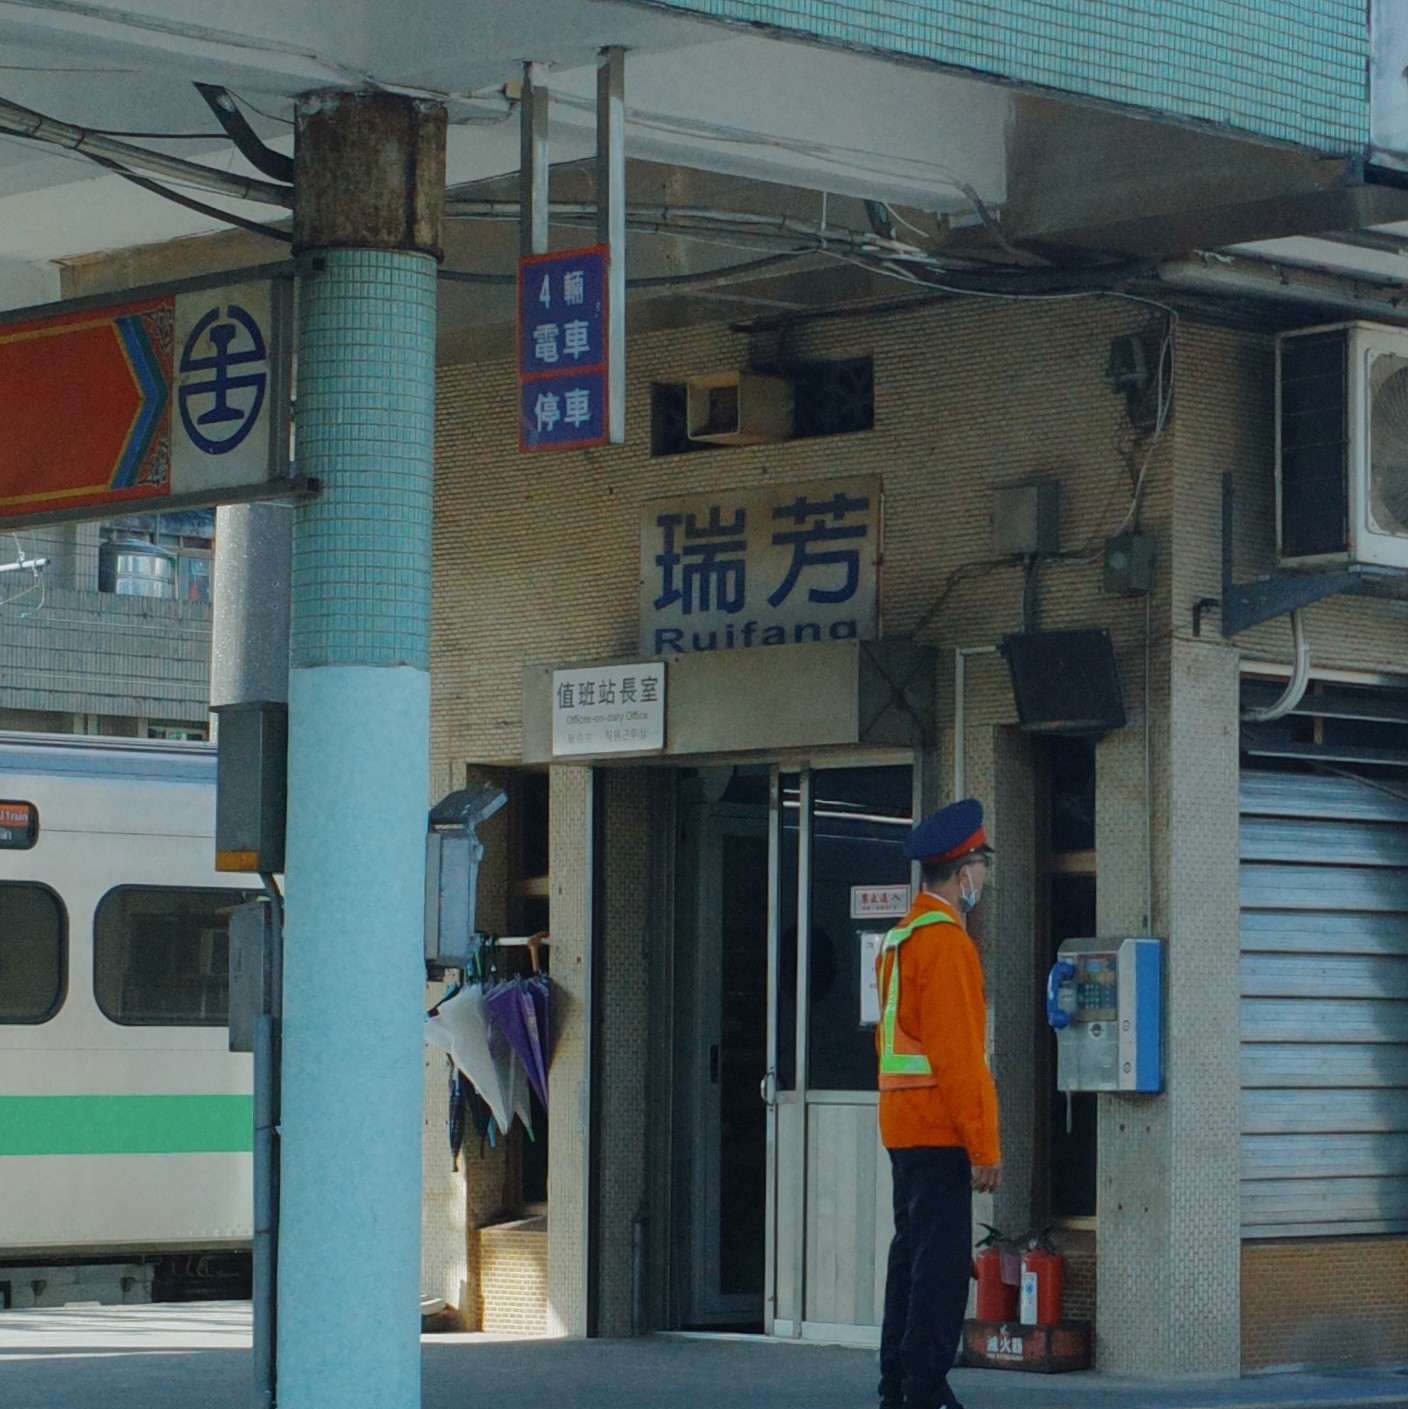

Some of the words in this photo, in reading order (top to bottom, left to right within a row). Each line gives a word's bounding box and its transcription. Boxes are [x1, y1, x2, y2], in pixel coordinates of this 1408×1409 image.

[533, 319, 590, 363] 電車
[534, 387, 591, 433] 停車
[654, 493, 870, 615] 瑞芳
[557, 676, 658, 710] 值班站長室
